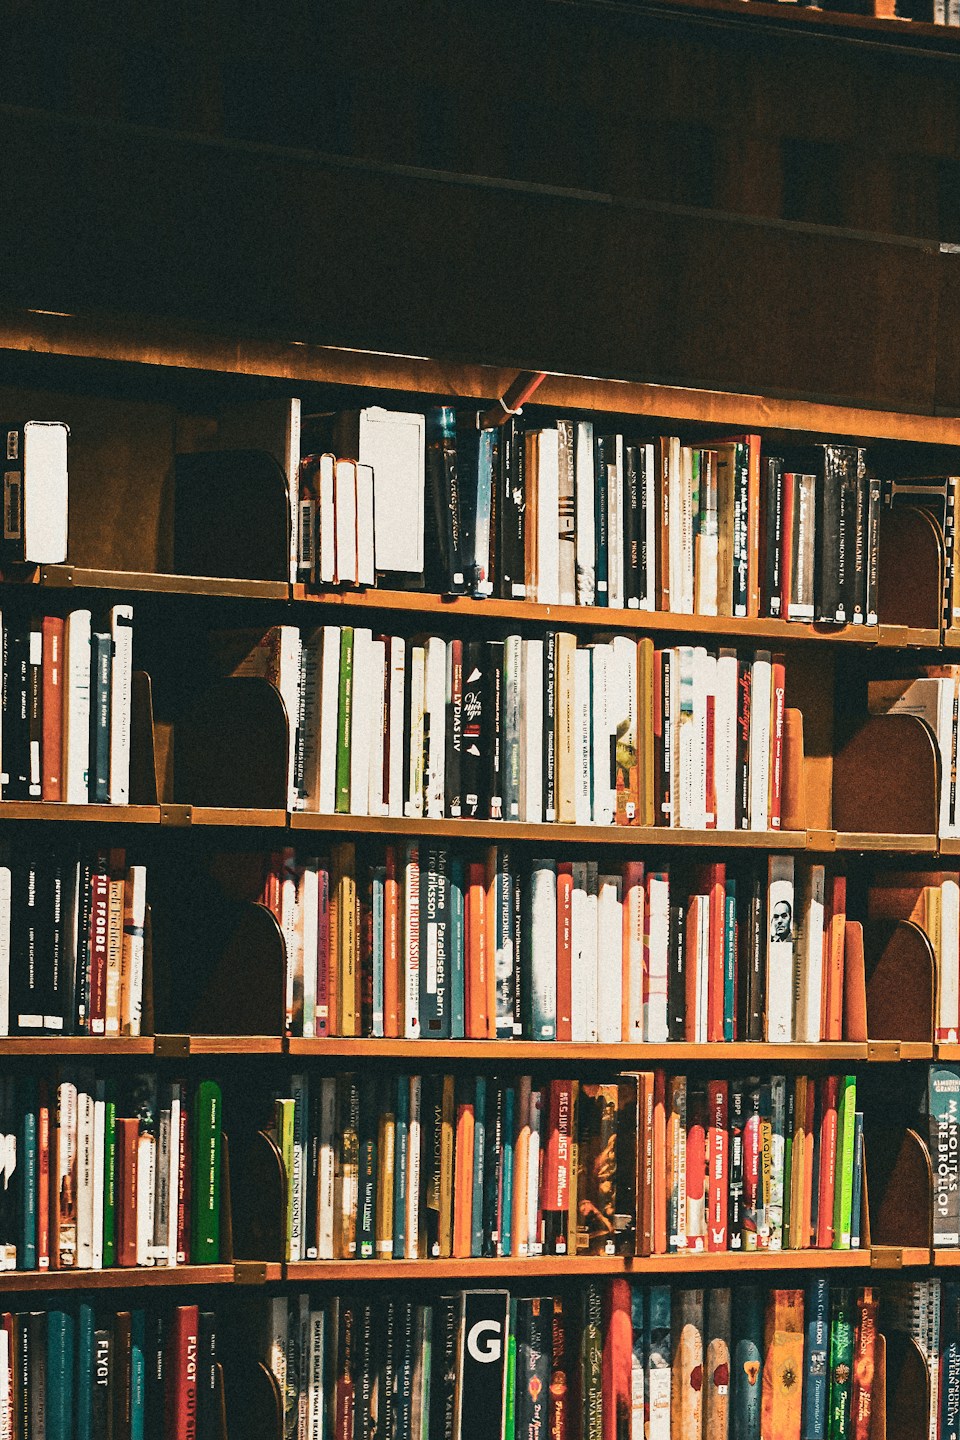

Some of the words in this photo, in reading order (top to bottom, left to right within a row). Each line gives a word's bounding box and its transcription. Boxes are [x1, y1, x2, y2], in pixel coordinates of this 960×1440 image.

[559, 496, 575, 543] III-V
[855, 525, 863, 572] SAMLAREN
[438, 850, 447, 909] Marianne
[96, 902, 106, 952] FFORDE
[409, 903, 420, 970] FREDRIKSSON
[437, 922, 446, 984] Paradisets
[436, 988, 446, 1016] barn
[715, 1135, 723, 1150] ATT
[939, 1113, 948, 1139] TRE
[948, 1099, 958, 1191] MANOLITAS
[715, 1154, 723, 1179] VINNA
[938, 1144, 950, 1216] BRÖLLOP
[97, 1340, 109, 1386] FLYGT
[187, 1336, 197, 1382] FLYGT
[467, 1319, 502, 1363] G
